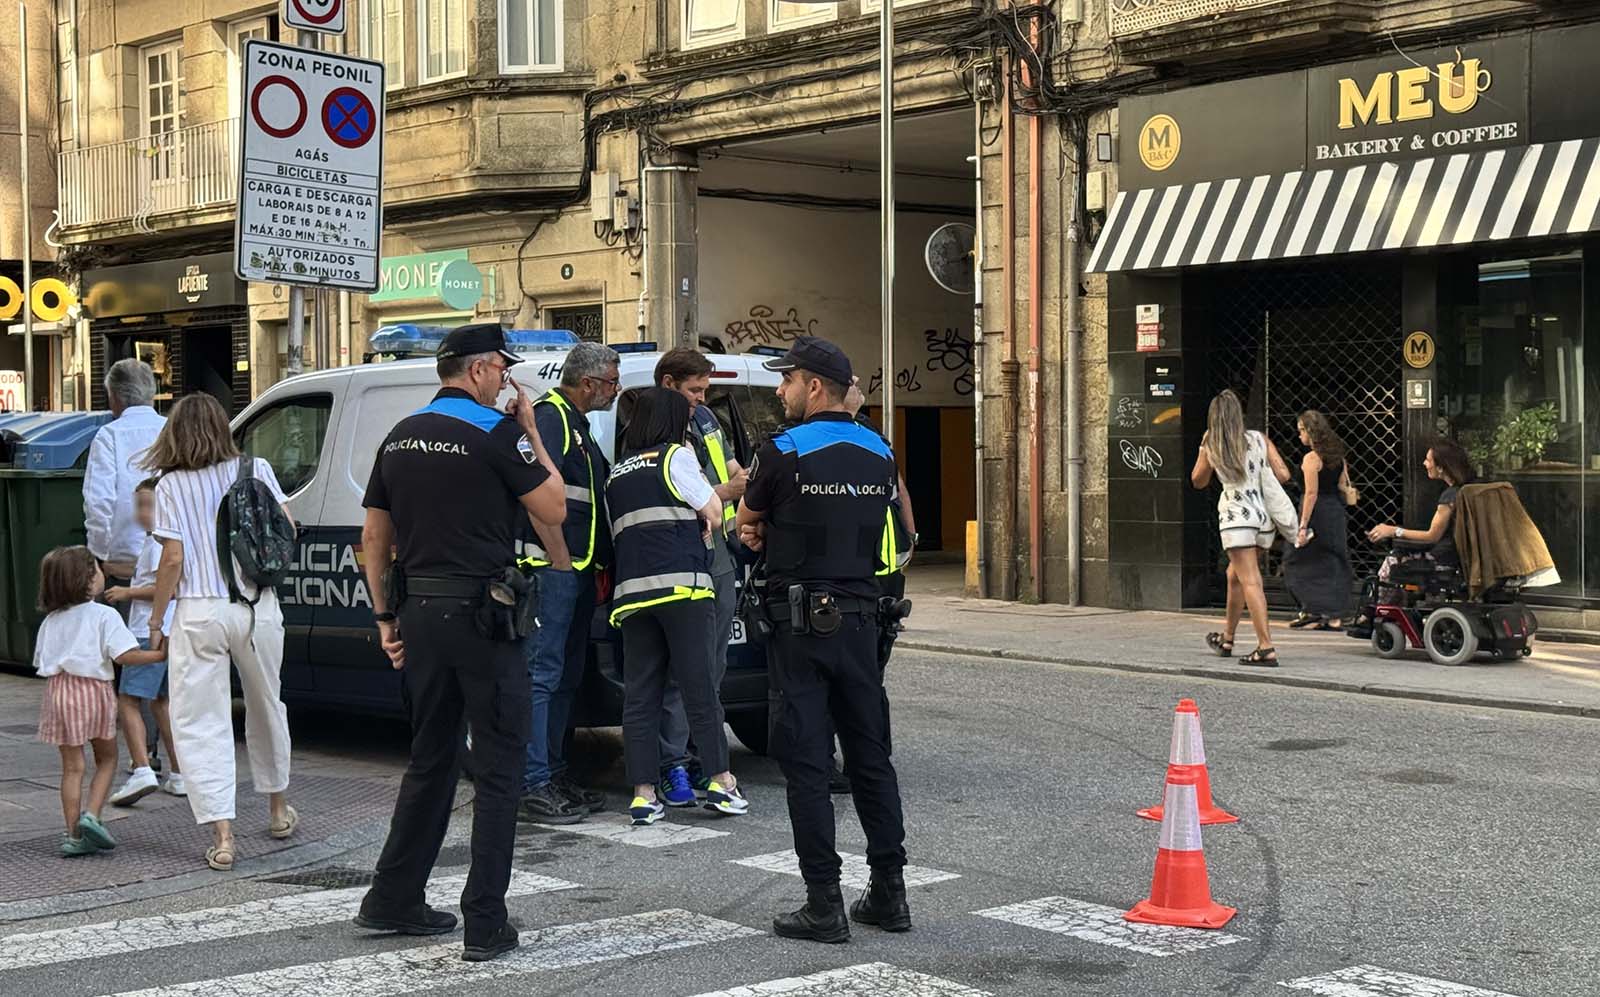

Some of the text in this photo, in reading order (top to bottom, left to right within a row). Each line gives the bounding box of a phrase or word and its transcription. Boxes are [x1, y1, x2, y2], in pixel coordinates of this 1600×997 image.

[257, 50, 373, 84] ZONA PEONIL
[1338, 58, 1482, 130] MEU
[1148, 125, 1171, 150] M
[1316, 121, 1517, 160] BAKERY & COFFEE
[295, 147, 329, 163] AGÁS
[277, 164, 348, 184] BICICLETAS
[248, 180, 373, 207] CARGA E DESCARGA
[258, 197, 366, 220] LABORAIS DE 8 A 12
[272, 213, 279, 223] E
[282, 215, 297, 226] DE
[300, 217, 311, 227] 16
[314, 219, 322, 229] A
[295, 230, 320, 242] MIN.
[268, 246, 355, 266] AUTORIZADOS
[309, 266, 361, 280] MINUTOS
[380, 262, 447, 291] MONE
[178, 273, 209, 294] LAFUENTE
[445, 280, 480, 289] MONET
[1411, 339, 1428, 354] M
[383, 436, 469, 455] POLICÍA LOCAL
[801, 482, 886, 495] POLICÍA LOCAL
